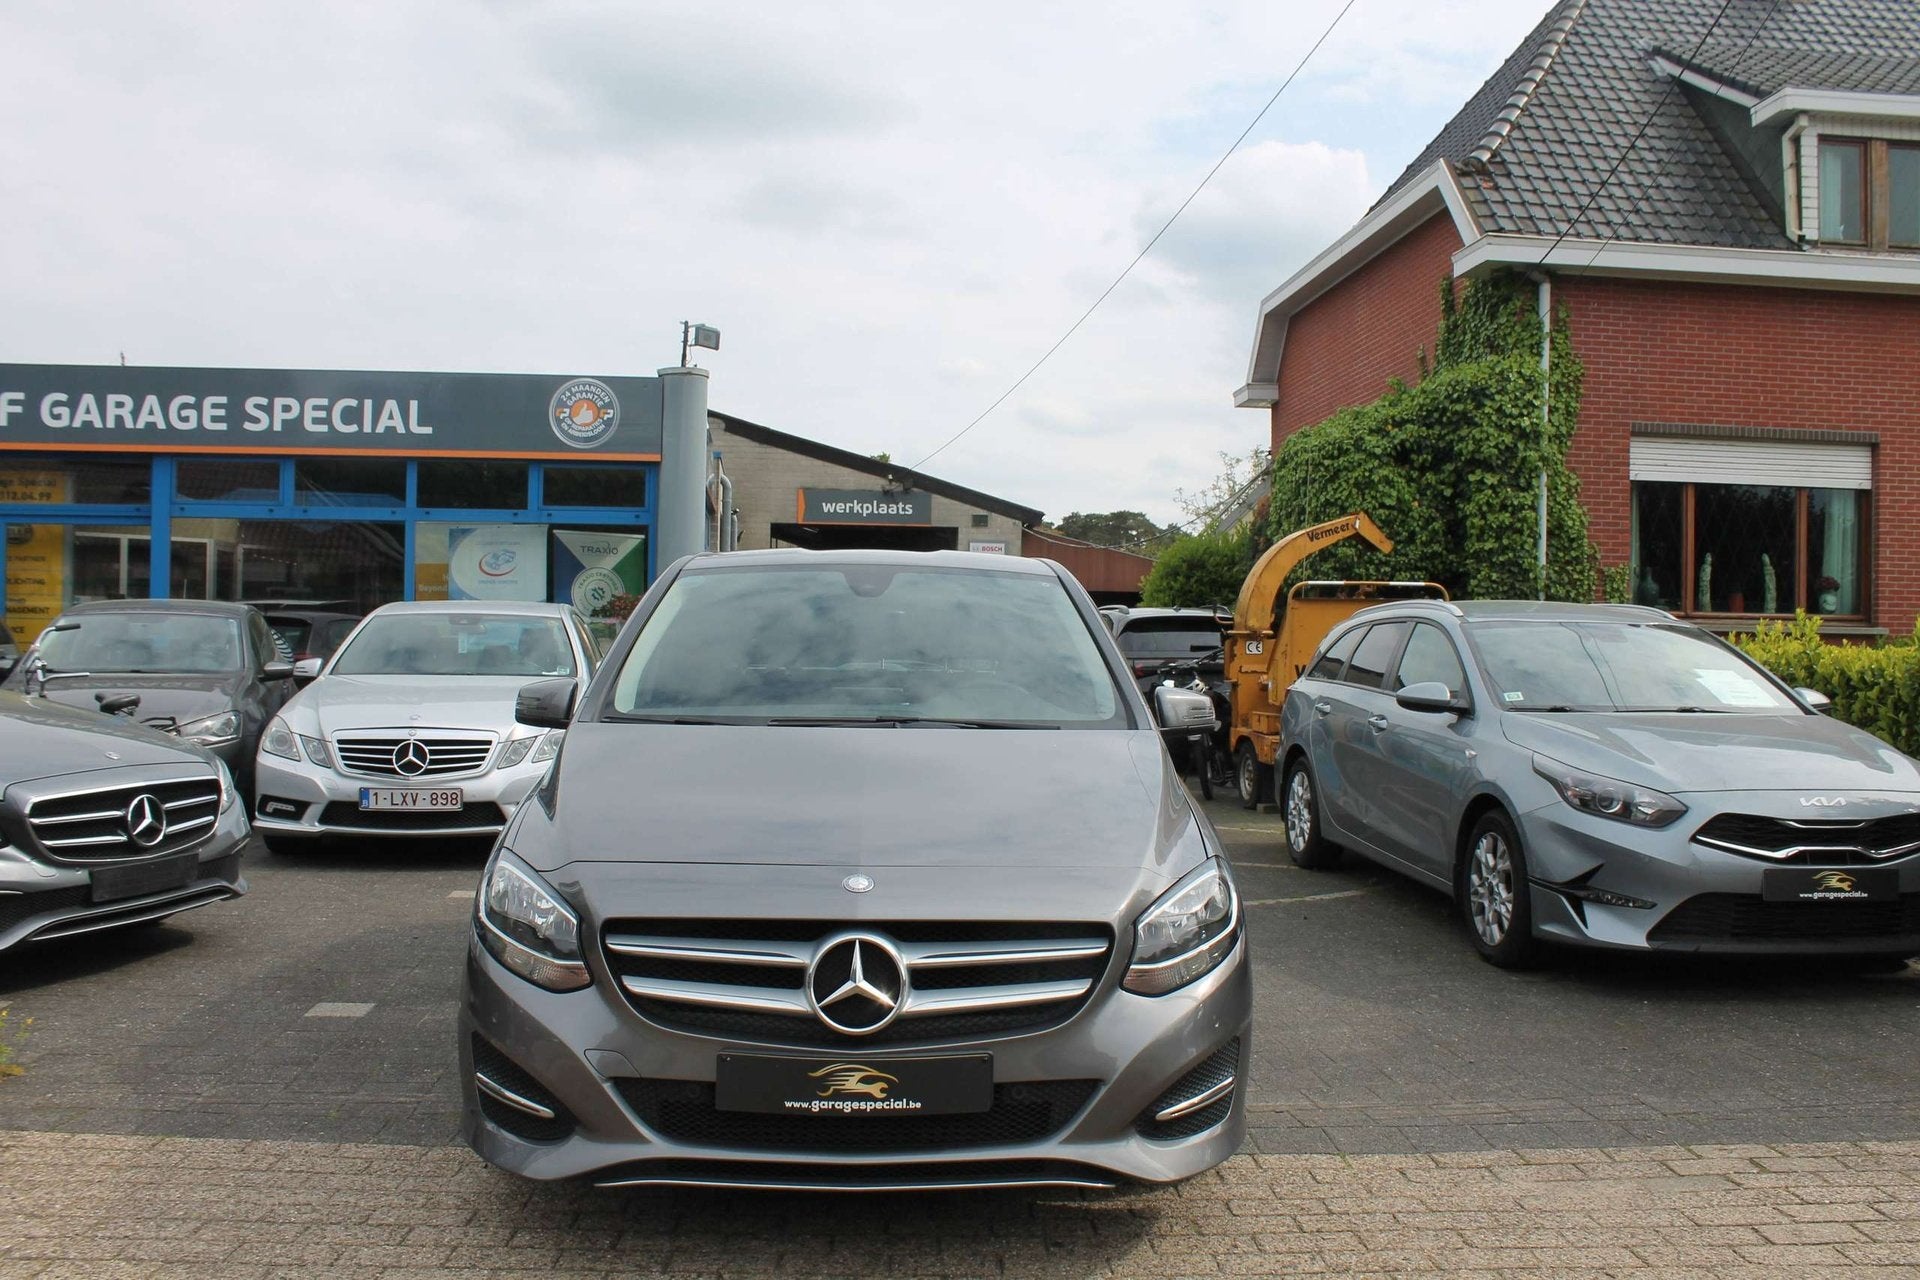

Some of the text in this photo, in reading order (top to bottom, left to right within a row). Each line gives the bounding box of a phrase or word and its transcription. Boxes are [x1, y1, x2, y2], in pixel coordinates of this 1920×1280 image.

[561, 384, 611, 404] 24 MAANDEN
[566, 392, 605, 408] GARANTIE
[40, 392, 228, 431] GARAGE
[242, 396, 433, 435] SPECIAL
[822, 500, 914, 517] werkplaats
[1307, 522, 1351, 543] Vermeer
[580, 545, 619, 555] TRAXIO
[981, 545, 1003, 553] BOSCH
[1246, 641, 1262, 653] CE
[1799, 890, 1868, 899] www.garagespecial.be
[784, 1098, 922, 1113] www.garagespecial.be
